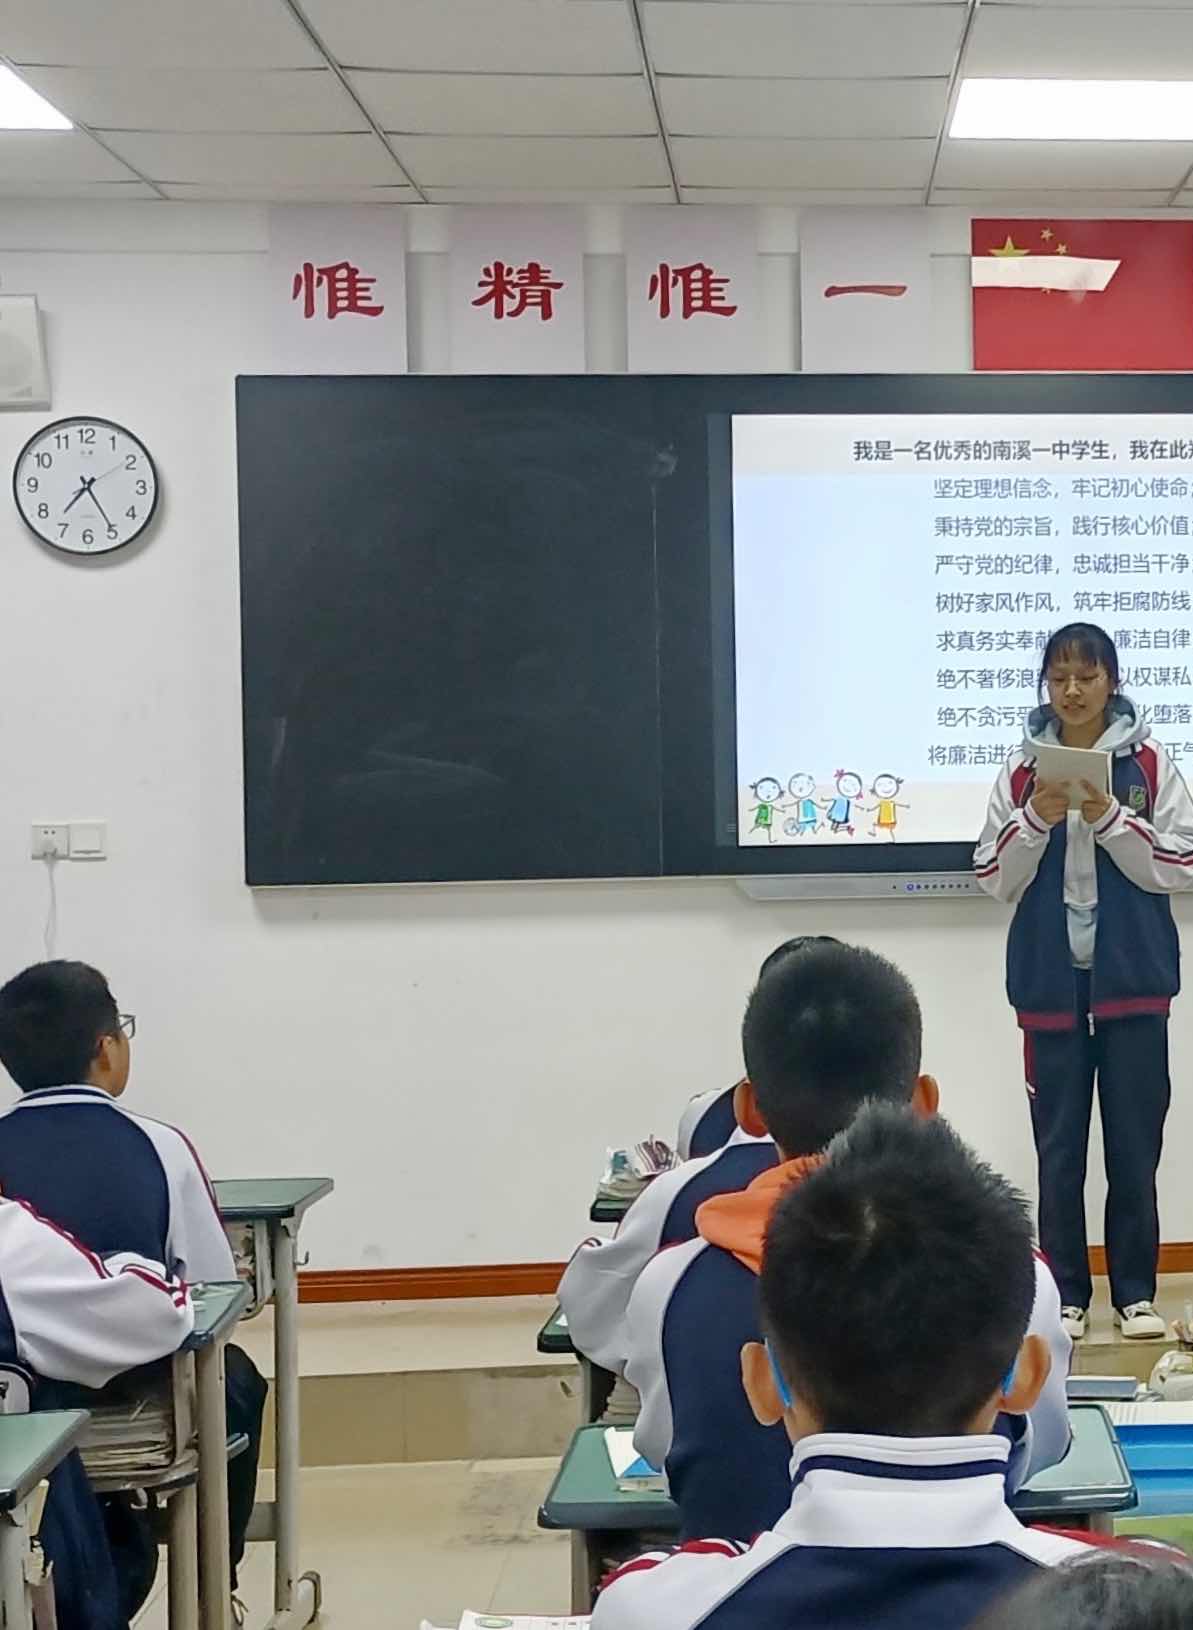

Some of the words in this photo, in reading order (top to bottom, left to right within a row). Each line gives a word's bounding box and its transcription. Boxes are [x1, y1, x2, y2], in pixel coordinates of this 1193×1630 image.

[54, 434, 69, 450] 11
[78, 428, 96, 444] 12
[109, 435, 116, 451] 1
[34, 452, 52, 469] 10
[125, 454, 137, 470] 2
[27, 477, 39, 493] 9
[135, 479, 147, 495] 3
[38, 503, 49, 519] 8
[125, 505, 137, 520] 4
[57, 523, 69, 538] 7
[82, 529, 94, 544] 6
[106, 524, 118, 540] 5
